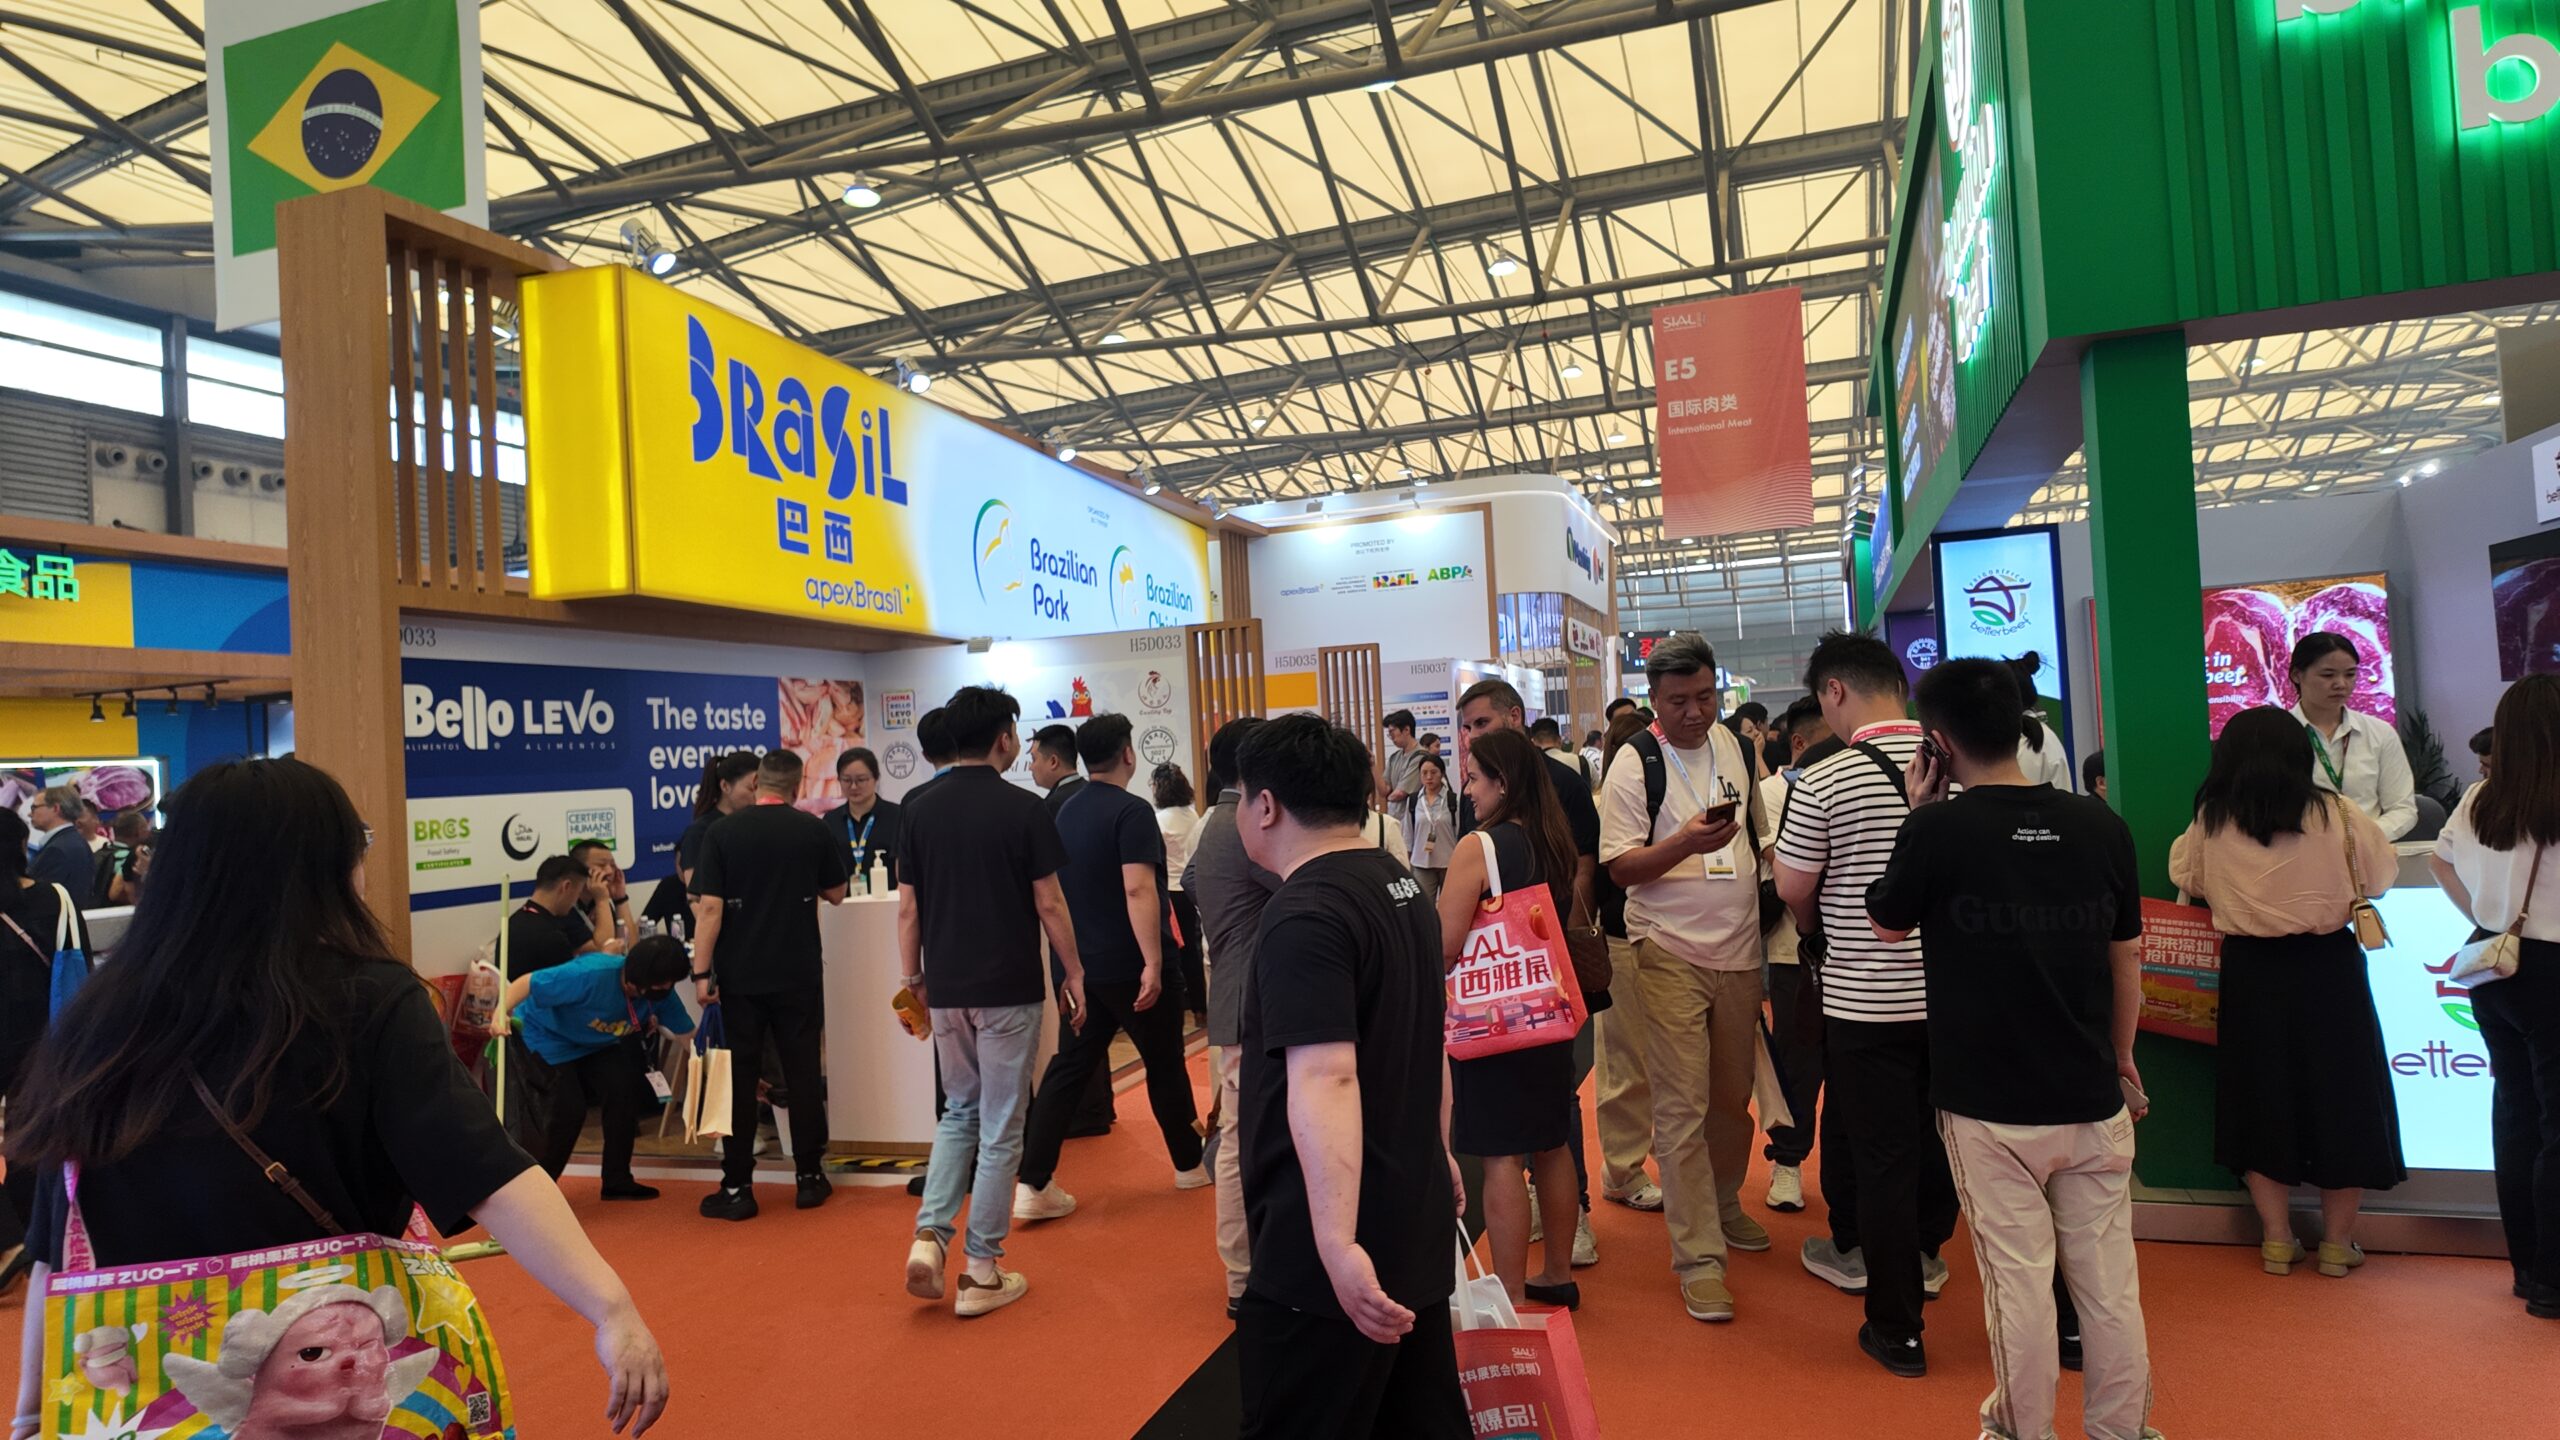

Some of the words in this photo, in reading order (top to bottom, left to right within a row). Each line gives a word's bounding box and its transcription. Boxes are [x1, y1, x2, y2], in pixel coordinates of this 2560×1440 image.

[1662, 314, 1697, 330] SIAL
[1664, 357, 1697, 382] E5
[1667, 393, 1738, 418] 国际肉类
[1667, 419, 1726, 436] International
[1728, 418, 1753, 429] Meat
[776, 497, 853, 565] 巴西
[1030, 537, 1098, 587] Brazilian
[1427, 565, 1473, 582] ABPA
[805, 577, 903, 615] apexBrasil
[1146, 573, 1193, 612] Brazilian
[1032, 583, 1070, 622] Pork
[1130, 635, 1182, 652] H5D033
[1275, 654, 1317, 668] H5D035
[2213, 651, 2232, 667] in
[1410, 662, 1447, 675] H5D037
[403, 684, 515, 750] Bello
[523, 689, 615, 735] LEVO
[646, 697, 697, 731] The
[704, 701, 766, 731] taste
[405, 743, 460, 751] ALIMENTOS
[525, 741, 616, 750] ALIMENTOS
[568, 811, 613, 824] CERTIFIED
[569, 822, 613, 834] HUMANE
[2016, 827, 2038, 835] Action
[2038, 827, 2051, 835] can
[2012, 833, 2035, 842] change
[2035, 833, 2060, 842] destiny
[1459, 954, 1552, 999] 西雅展
[168, 1305, 198, 1322] wink
[175, 1312, 205, 1327] wink
[1470, 1403, 1538, 1435] 爆品!
